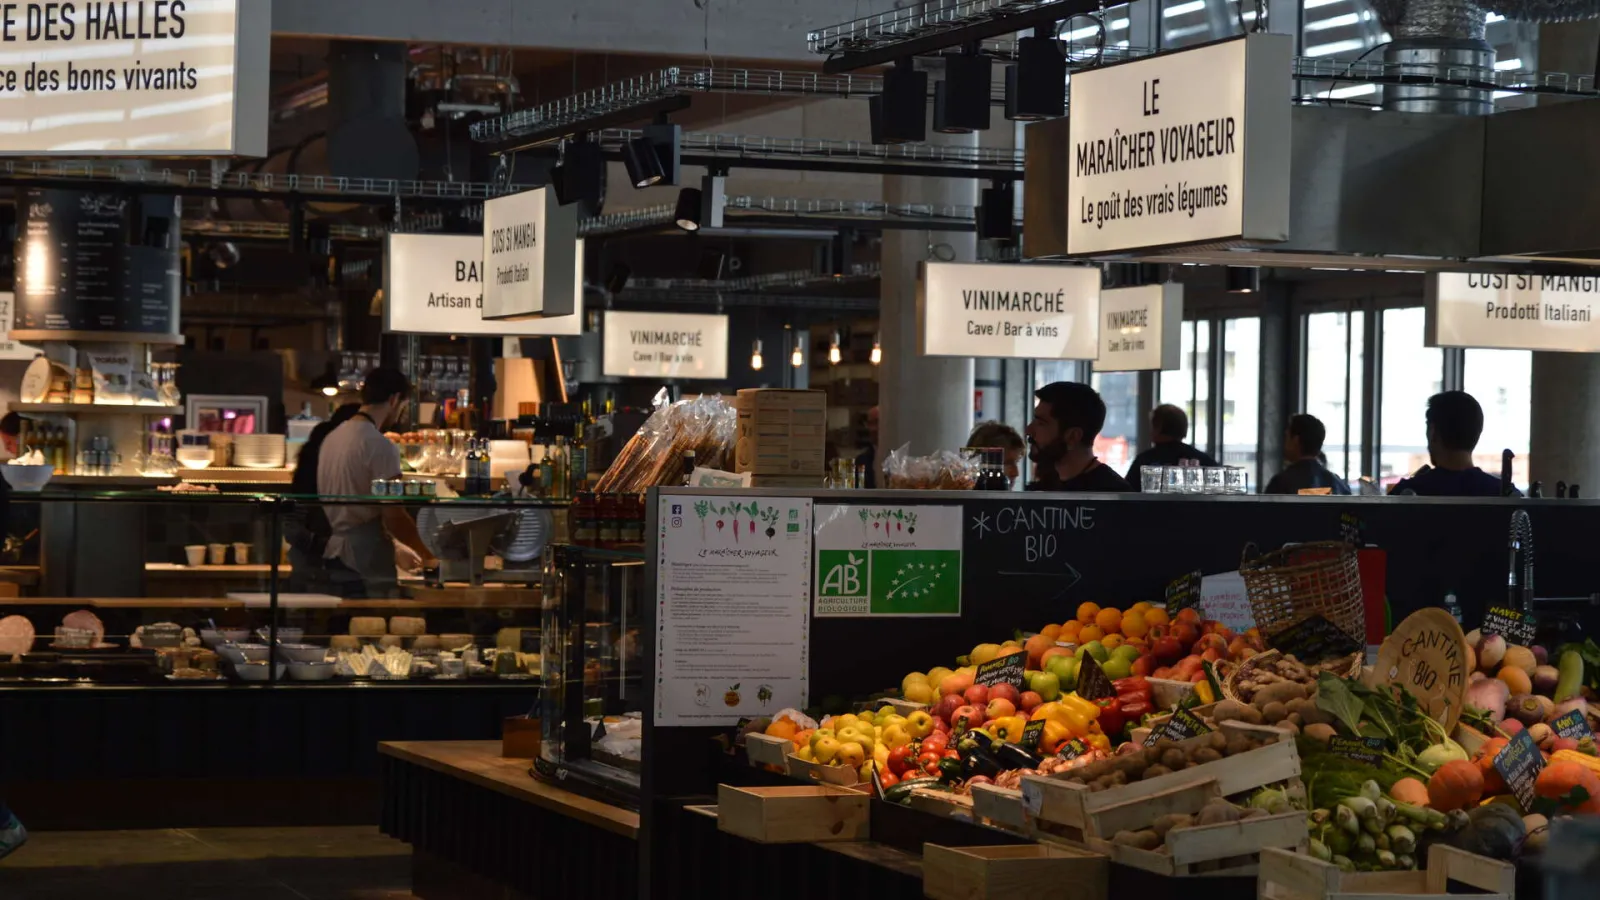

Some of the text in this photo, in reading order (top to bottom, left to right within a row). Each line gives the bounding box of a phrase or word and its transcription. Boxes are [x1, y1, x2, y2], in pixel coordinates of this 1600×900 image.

[0, 0, 186, 41] E DES HALLES
[25, 61, 60, 92] des
[67, 60, 116, 91] bons
[123, 61, 197, 90] vivants
[1143, 79, 1160, 117] LE
[1077, 116, 1235, 177] MARAÎCHER VOYAGEUR
[1081, 181, 1228, 229] Le goût des vrais légumes
[505, 226, 512, 252] SI
[513, 221, 536, 251] MANGIA
[455, 260, 484, 282] BA
[1541, 275, 1600, 293] MANGI
[427, 291, 471, 308] Artisan
[962, 288, 1064, 313] VINIMARCHÉ
[1107, 308, 1148, 330] VINIMARCHÉ
[1486, 301, 1591, 322] Prodotti Italiani
[630, 329, 702, 347] VINIMARCHÉ
[967, 321, 1058, 338] Cave / Bar à vins
[633, 351, 653, 363] Cave
[659, 352, 674, 363] Bar
[996, 506, 1096, 534] CANTINE
[744, 549, 779, 558] VOYAGEUR
[1025, 534, 1058, 562] BIO
[821, 564, 861, 595] AB
[818, 597, 868, 605] AGRICULTURE
[818, 605, 868, 613] BIOLOGIQUE
[1489, 606, 1524, 621] NAVET
[1413, 659, 1437, 691] BIO
